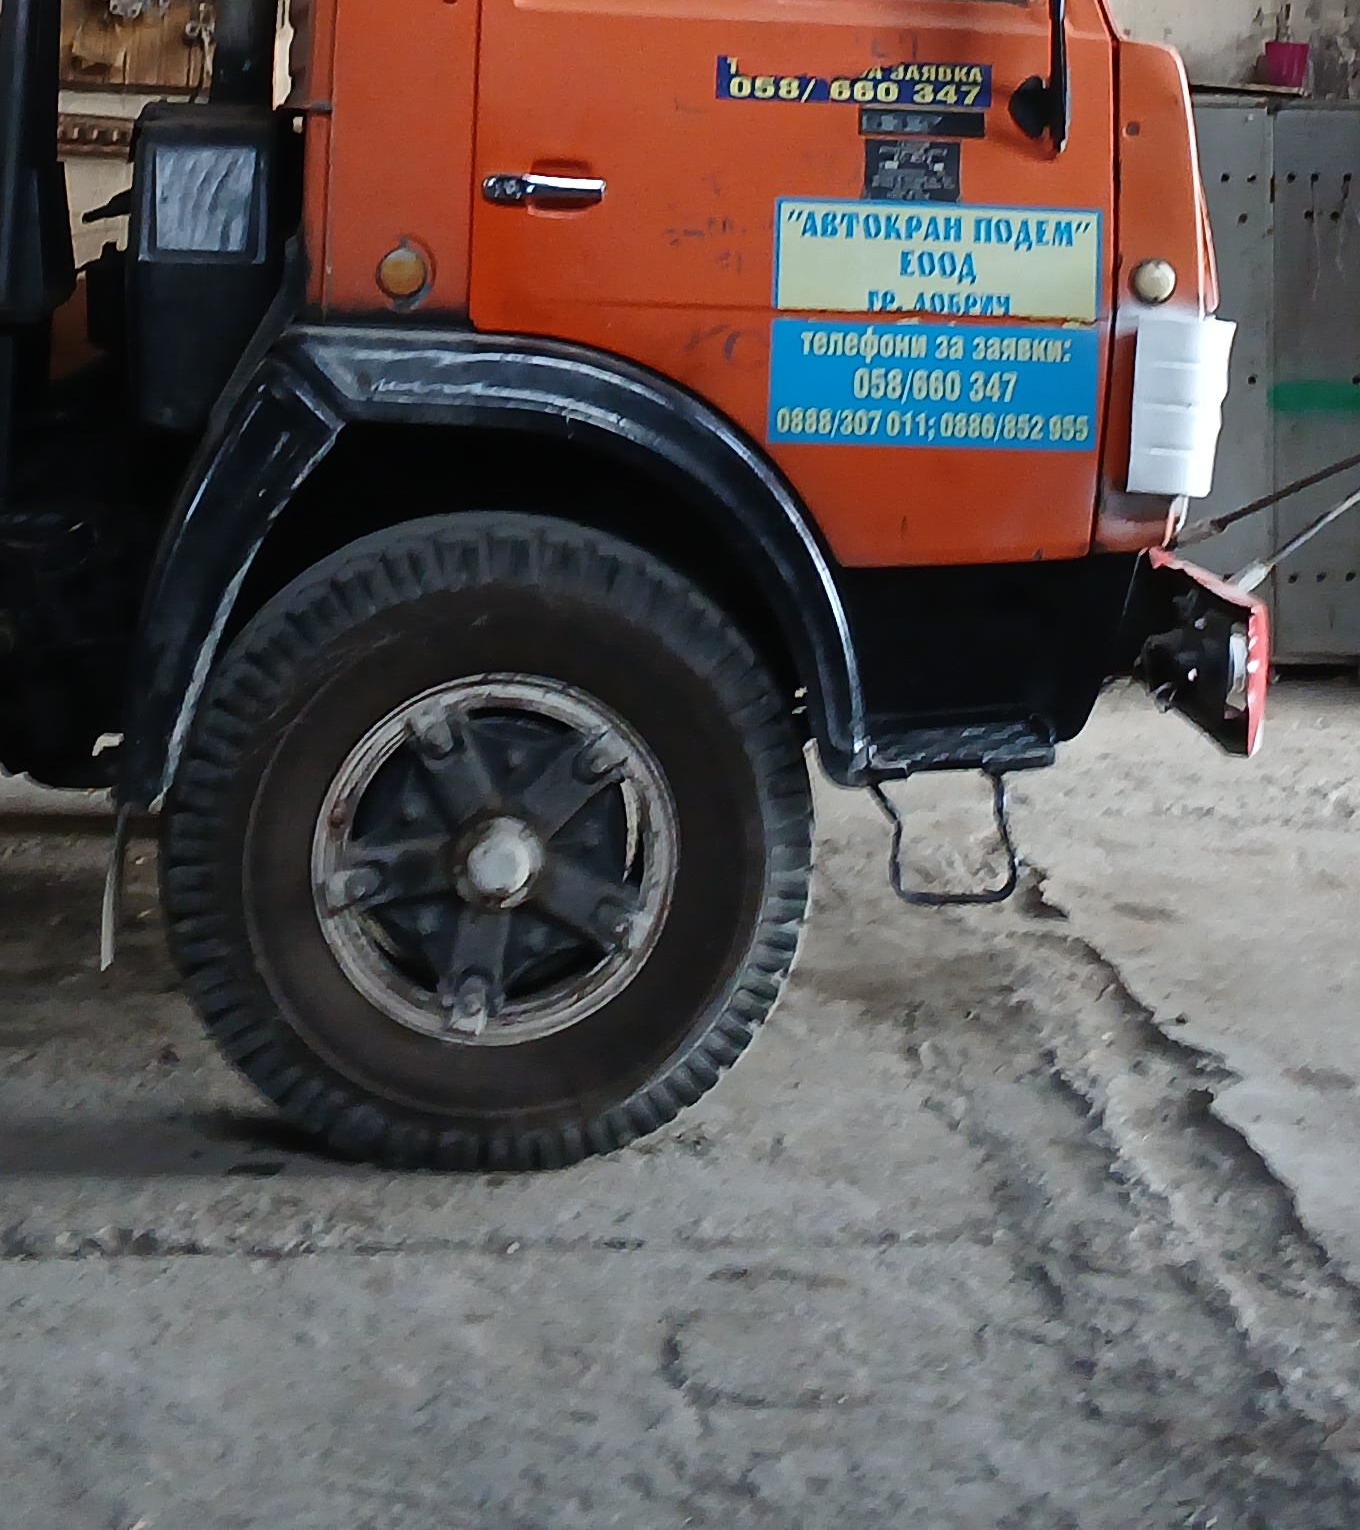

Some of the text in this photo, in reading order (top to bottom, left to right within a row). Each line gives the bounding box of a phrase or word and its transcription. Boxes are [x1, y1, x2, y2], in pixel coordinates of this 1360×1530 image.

[830, 78, 899, 103] 660
[913, 82, 981, 106] 347
[899, 249, 977, 286] ЕООД
[801, 326, 1072, 364] телефони за заявки:
[853, 367, 1018, 405] 058/660 347
[776, 406, 883, 439] 0888/307
[886, 409, 936, 442] 011;
